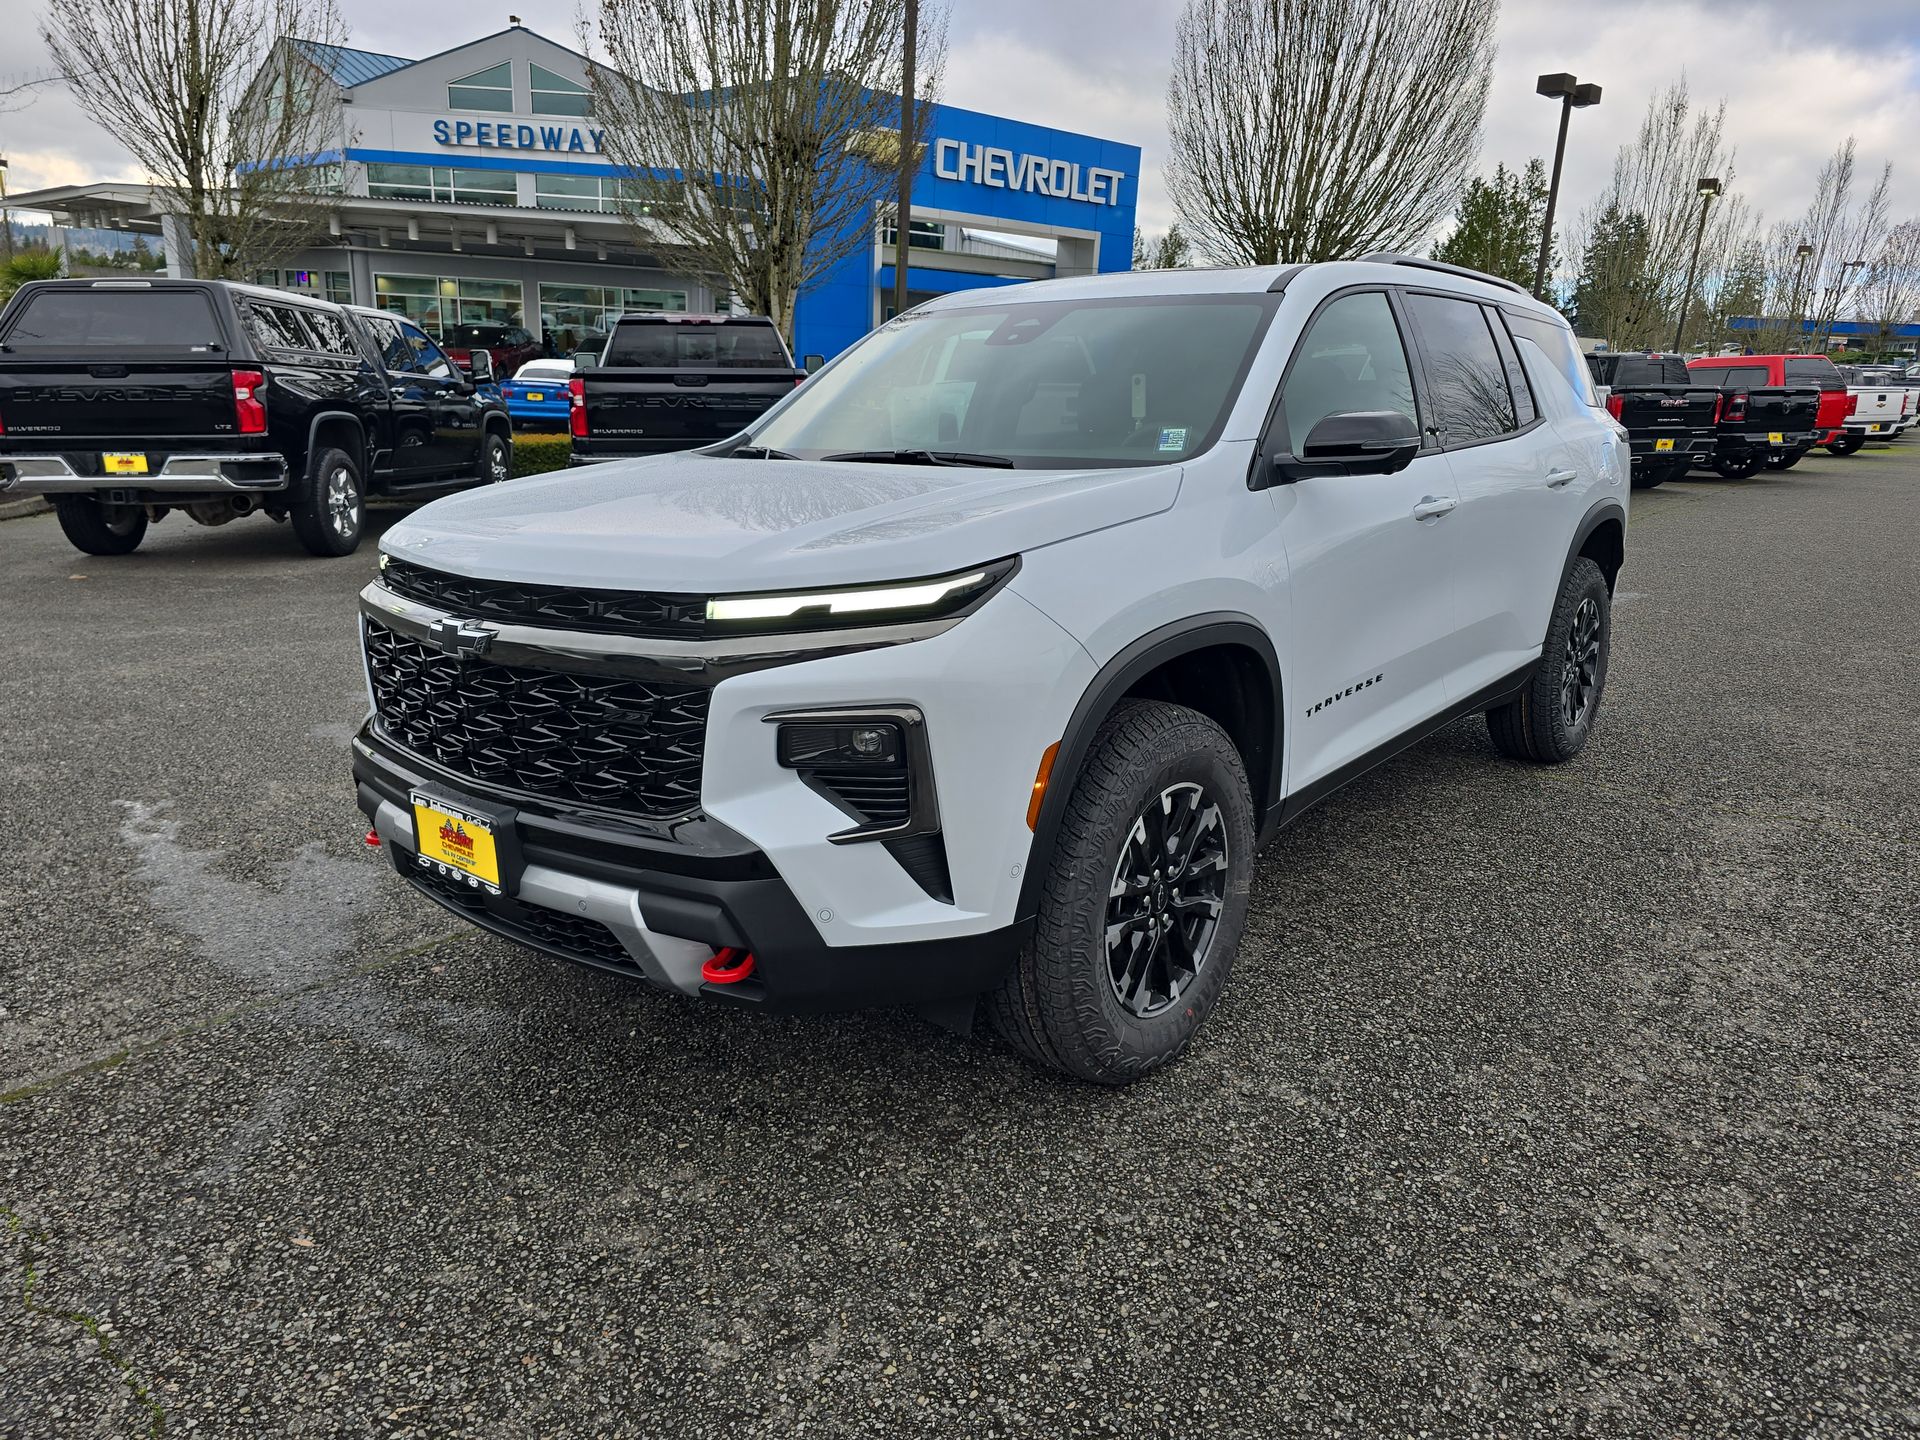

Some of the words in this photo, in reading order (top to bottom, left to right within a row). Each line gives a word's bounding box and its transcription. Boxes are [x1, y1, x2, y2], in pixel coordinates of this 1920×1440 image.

[433, 119, 605, 153] SPEEDWAY
[935, 137, 1125, 206] CHEVROLET
[12, 390, 217, 402] CHEVROLET
[1305, 673, 1384, 718] TRAVERSE
